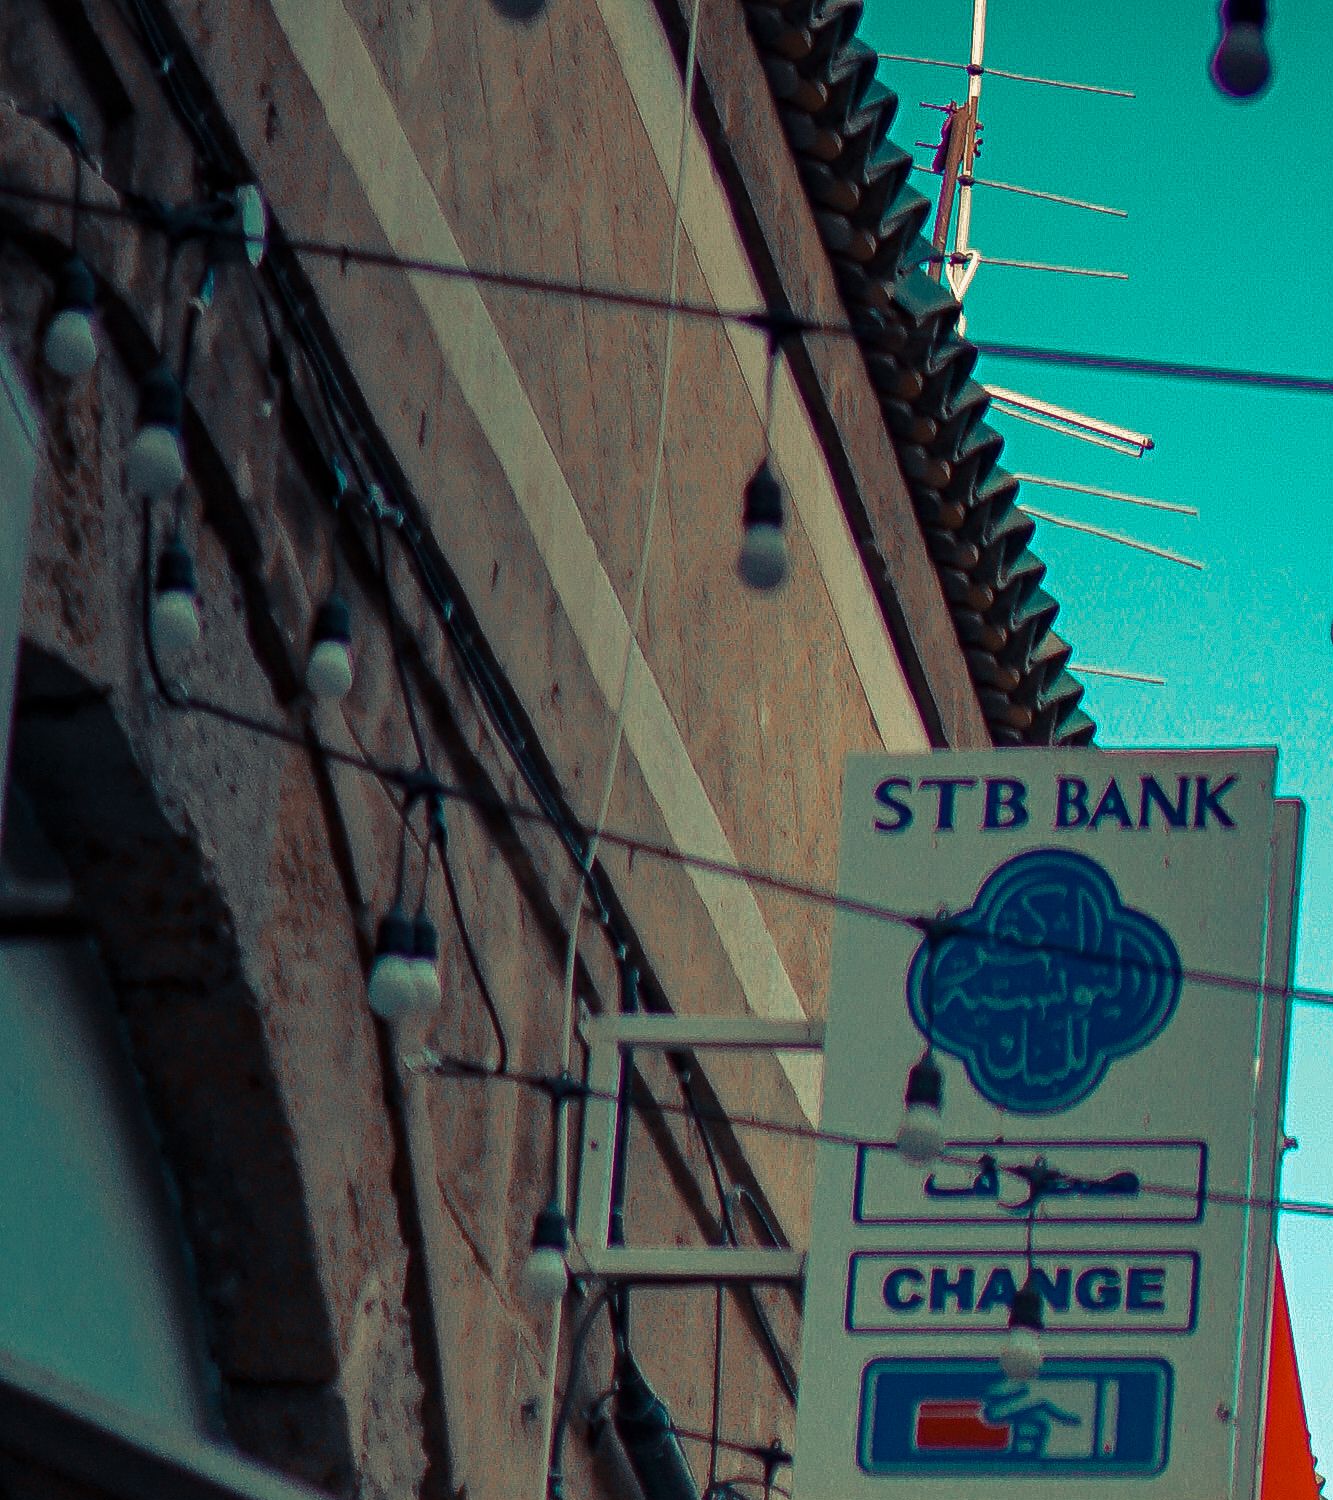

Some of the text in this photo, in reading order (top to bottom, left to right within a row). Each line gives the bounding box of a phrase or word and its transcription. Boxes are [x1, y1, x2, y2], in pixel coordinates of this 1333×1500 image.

[873, 775, 1238, 831] STB BANK
[883, 1267, 1166, 1312] CHANGE
